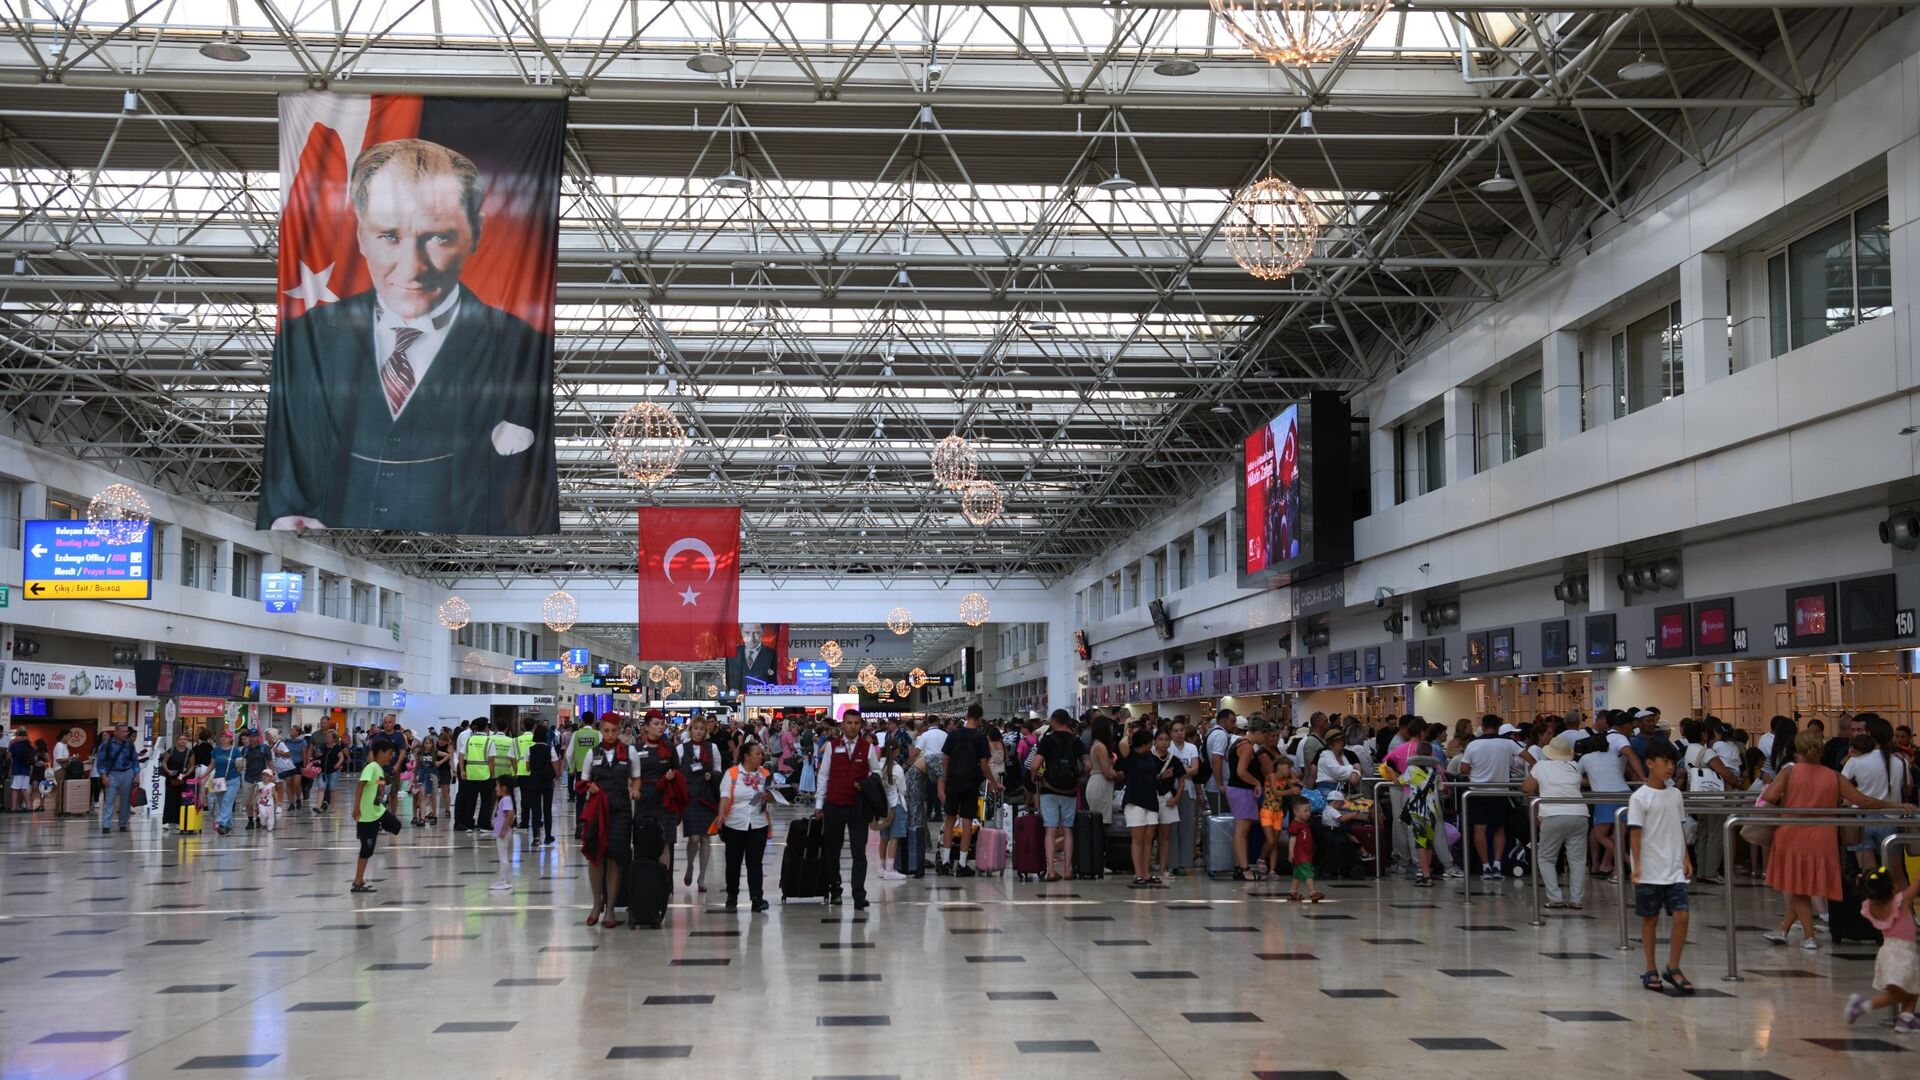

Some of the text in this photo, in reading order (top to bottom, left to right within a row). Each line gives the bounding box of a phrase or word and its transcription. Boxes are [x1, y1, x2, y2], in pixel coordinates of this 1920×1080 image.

[55, 553, 85, 564] Exchange
[86, 553, 106, 562] Office
[54, 567, 76, 575] Mescit
[76, 584, 89, 592] Exit
[95, 584, 121, 592] Выход
[1896, 611, 1914, 635] 150
[1733, 630, 1747, 650] 148
[1774, 626, 1788, 646] 149
[11, 667, 46, 691] Change
[94, 674, 114, 691] Döviz
[151, 766, 162, 811] wispotter
